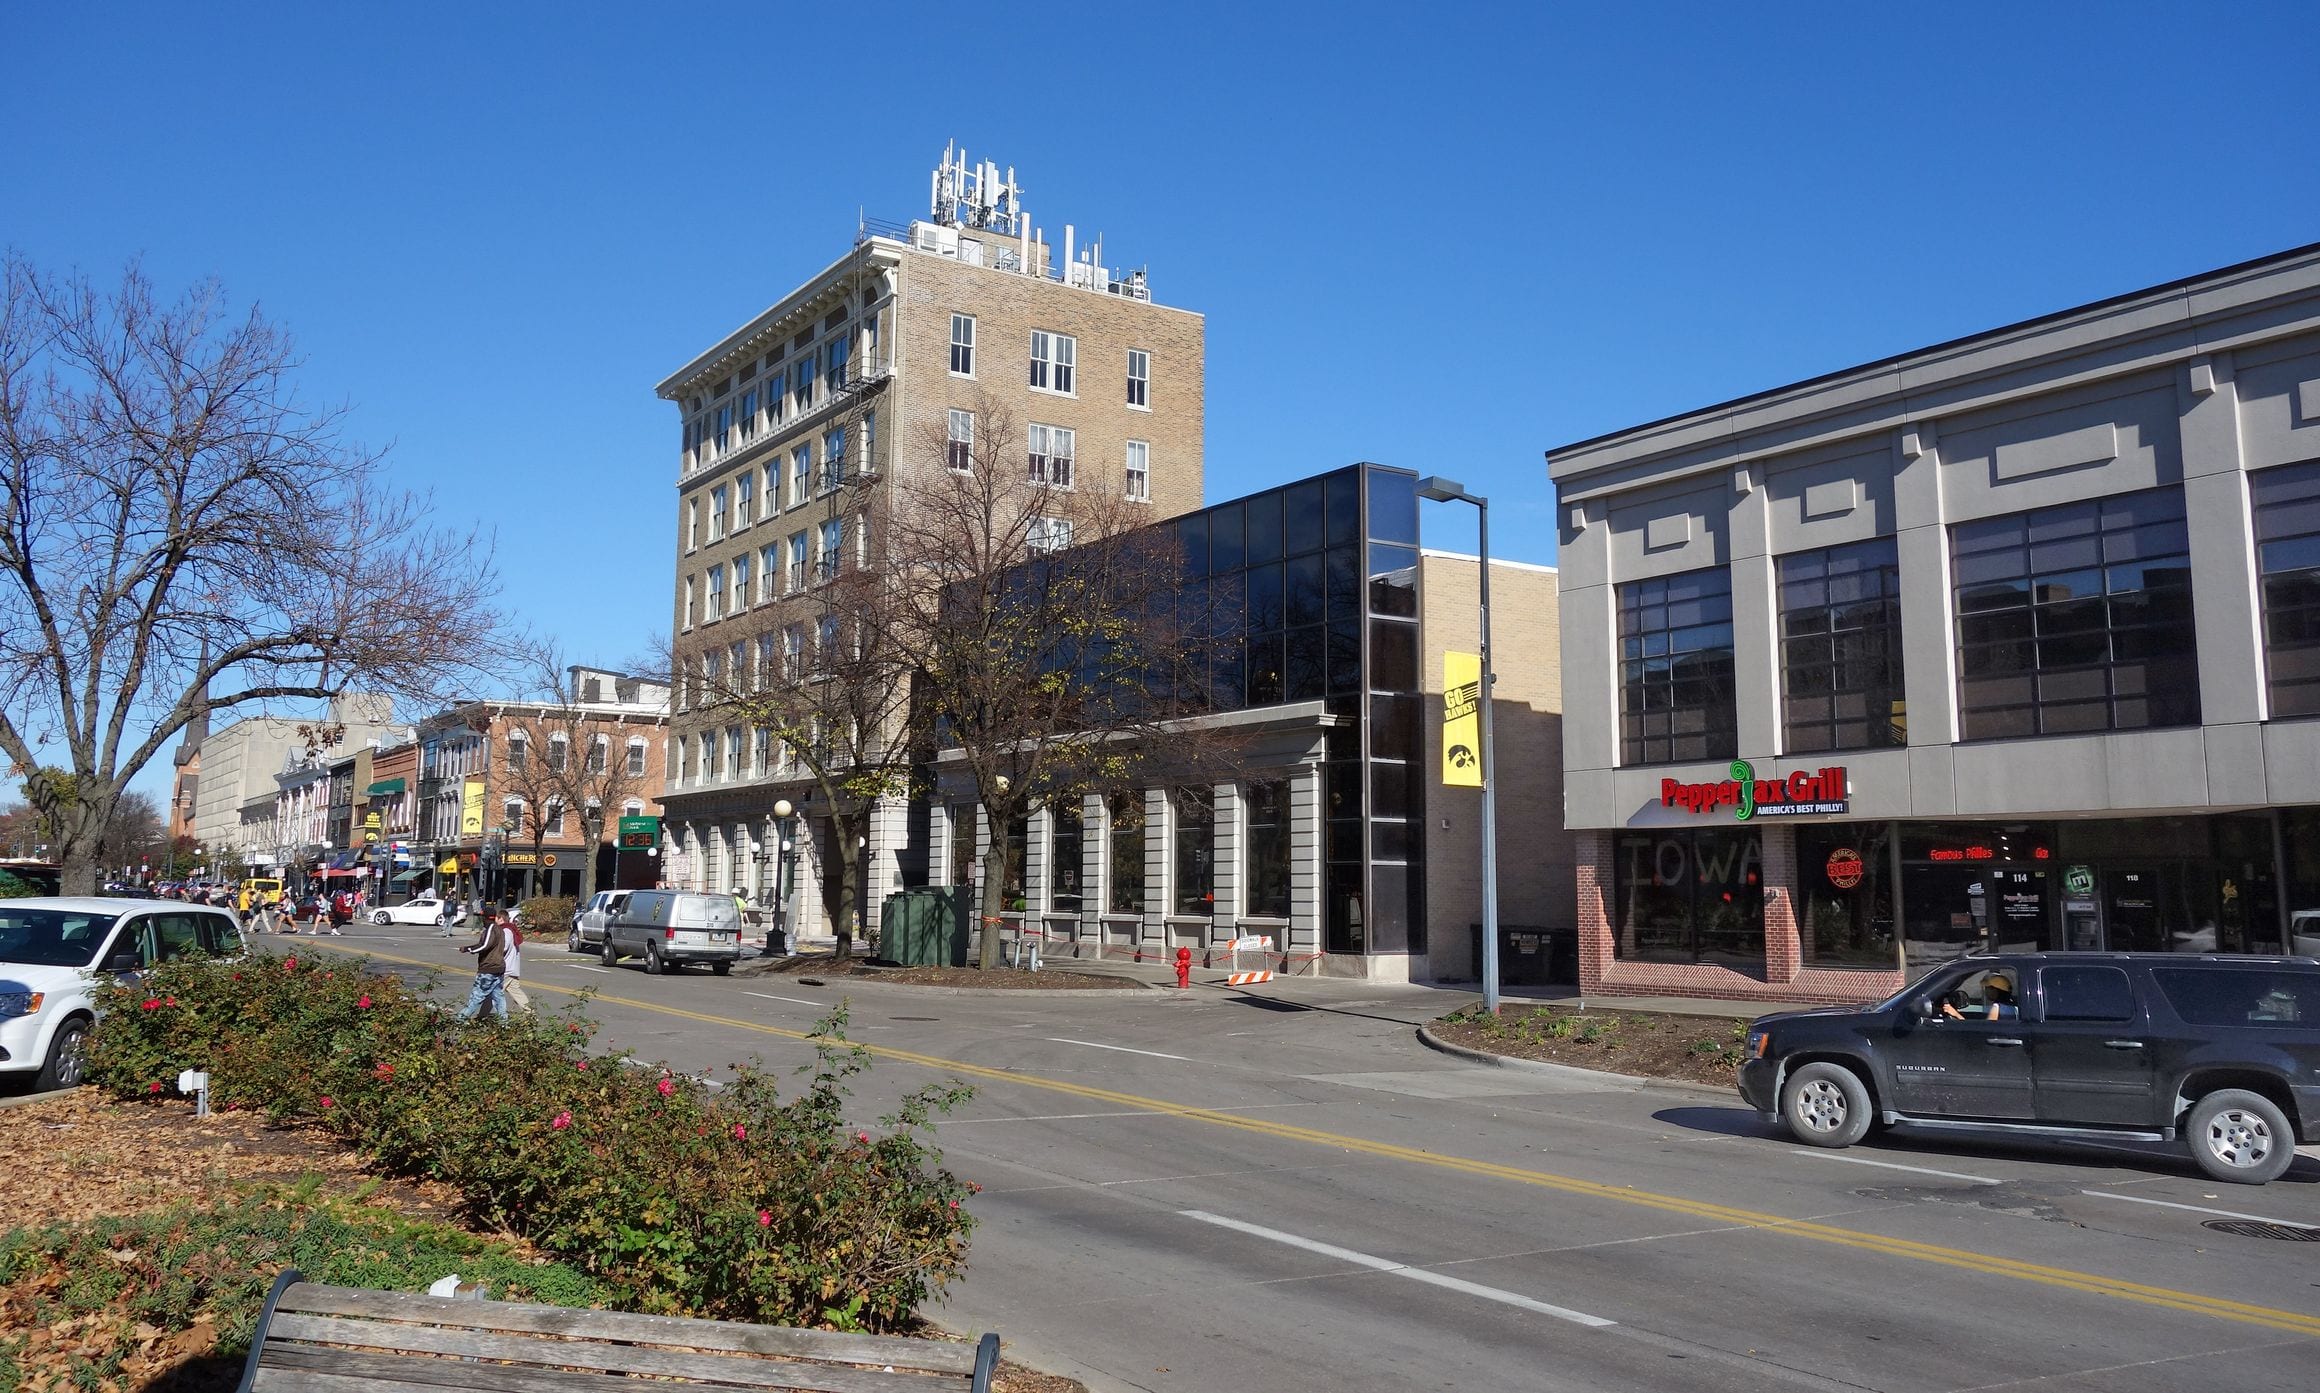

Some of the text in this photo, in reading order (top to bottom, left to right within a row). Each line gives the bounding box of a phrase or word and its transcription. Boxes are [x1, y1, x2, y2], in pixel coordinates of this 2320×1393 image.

[1444, 688, 1465, 709] GO
[1444, 700, 1477, 721] HAWKS!
[1788, 766, 1846, 802] Grill
[1756, 803, 1844, 815] AMERICA'S BEST PHILLY!
[1620, 837, 1763, 887] IOWA
[1828, 861, 1862, 876] BEST
[2012, 873, 2028, 883] 114
[2071, 874, 2088, 887] m
